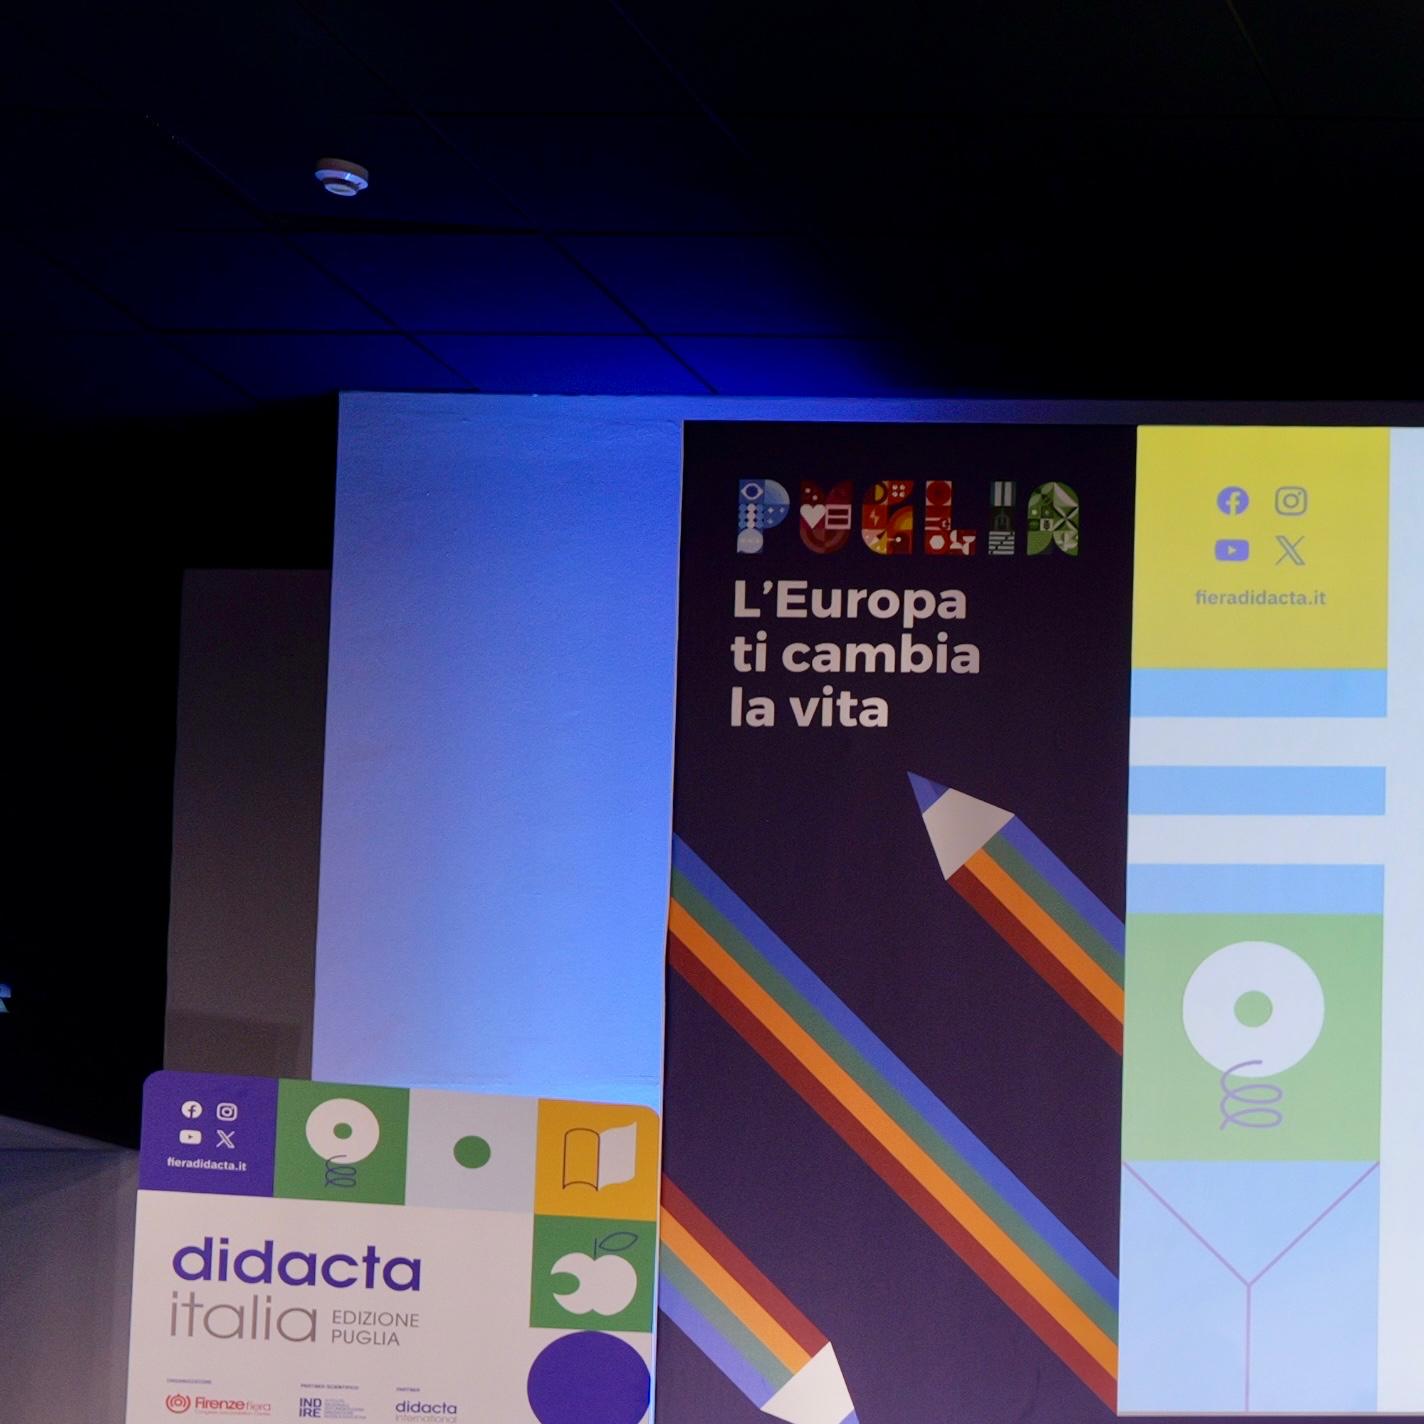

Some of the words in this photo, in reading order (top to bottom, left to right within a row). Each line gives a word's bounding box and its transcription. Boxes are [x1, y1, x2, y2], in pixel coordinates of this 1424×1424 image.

[736, 478, 1080, 556] PUGLIA
[733, 579, 968, 628] L'Europa
[1195, 589, 1326, 606] fieradidacta.it
[731, 630, 767, 673] ti
[781, 630, 980, 674] cambia
[731, 687, 775, 727] la
[789, 686, 889, 728] vita
[167, 1156, 247, 1172] fieradidacta.it
[172, 1236, 422, 1292] didacta
[170, 1290, 317, 1342] italia
[332, 1309, 420, 1329] EDIZIONE
[332, 1328, 400, 1347] PUGLIA
[395, 1400, 457, 1415] didacta
